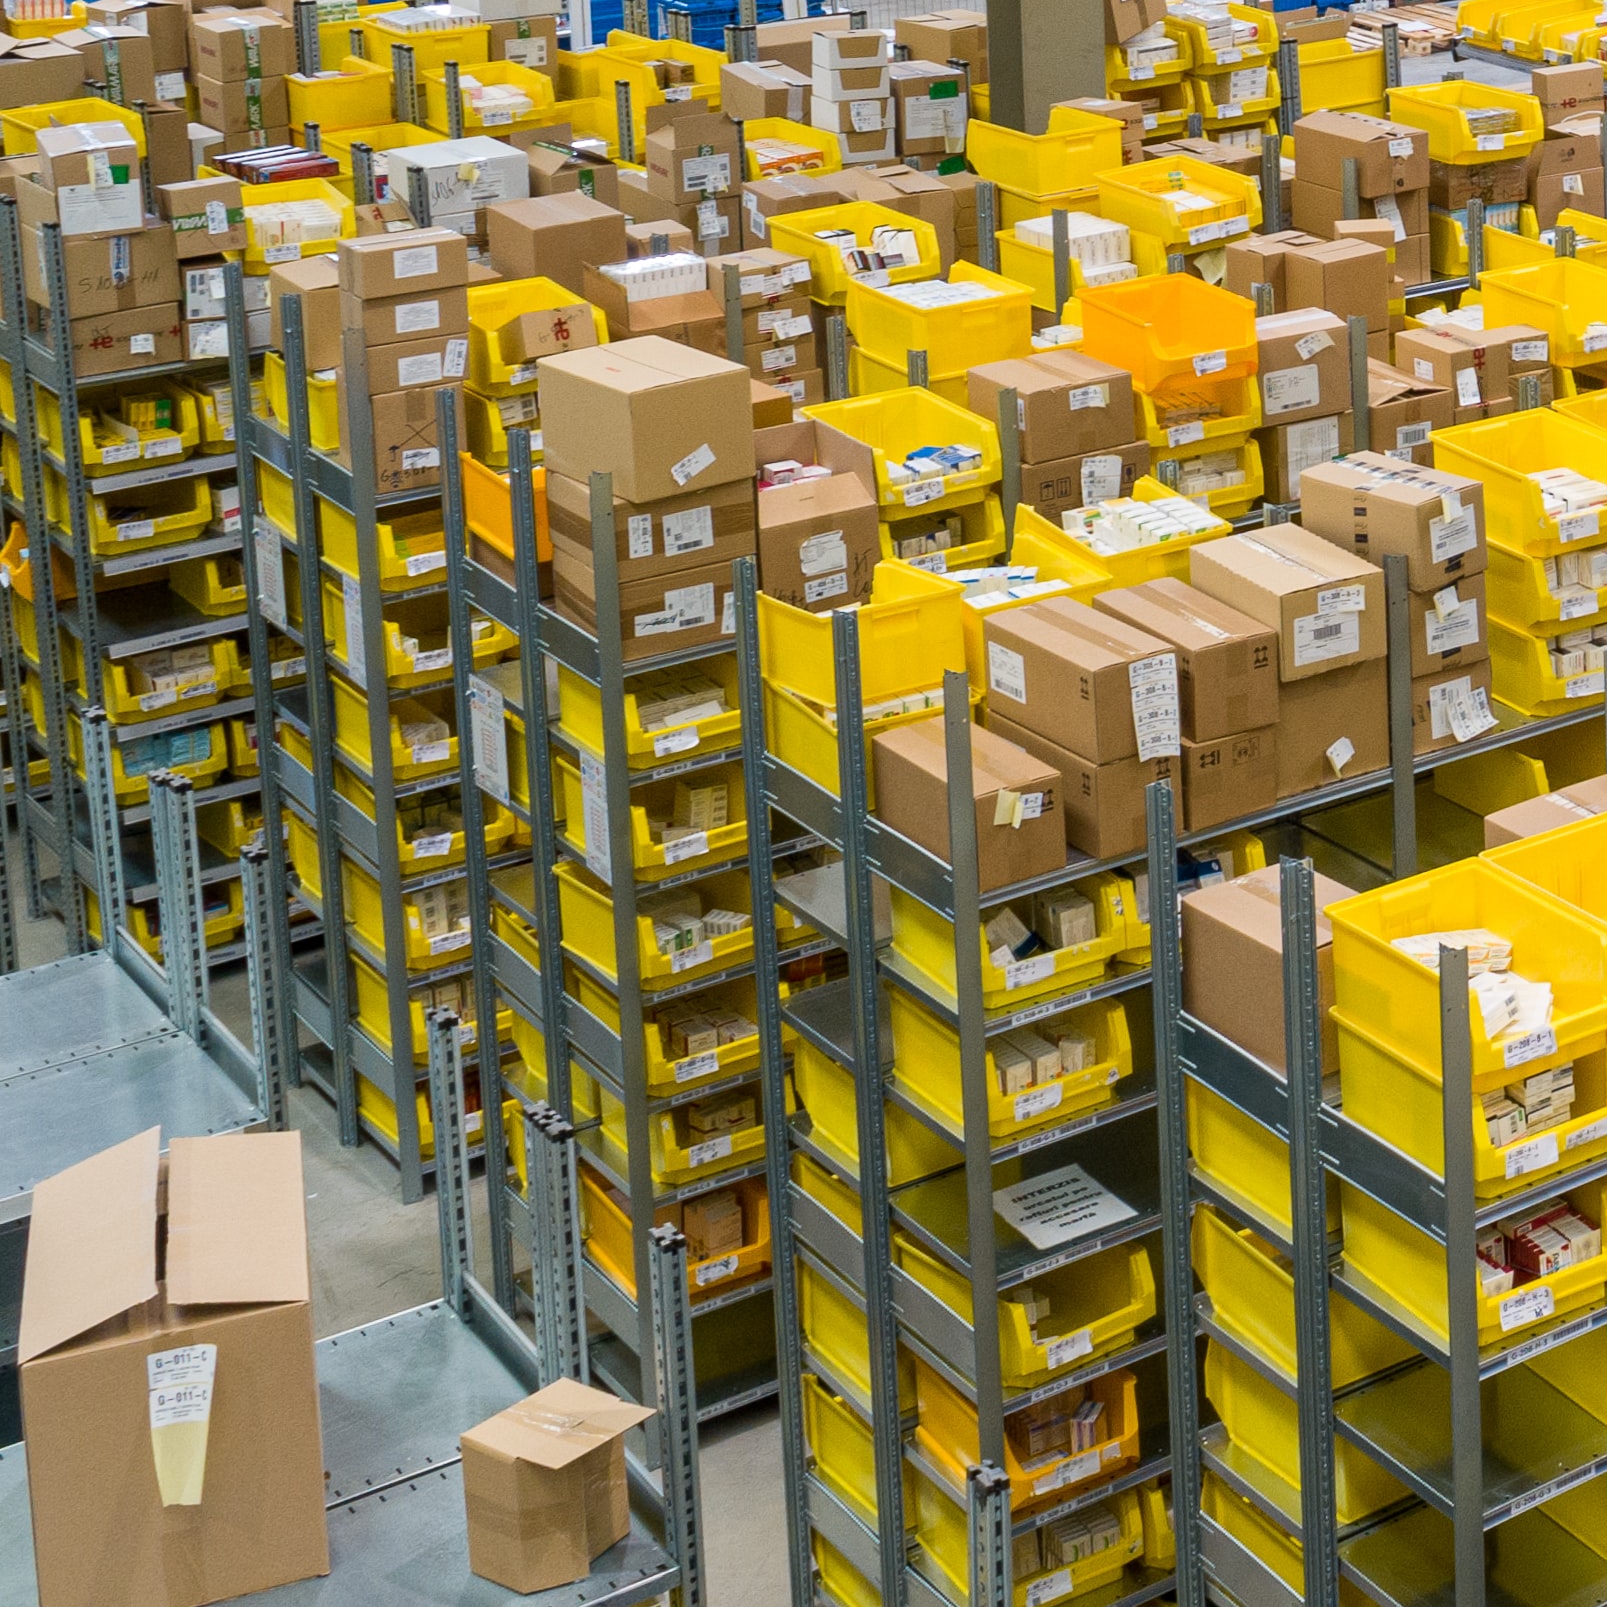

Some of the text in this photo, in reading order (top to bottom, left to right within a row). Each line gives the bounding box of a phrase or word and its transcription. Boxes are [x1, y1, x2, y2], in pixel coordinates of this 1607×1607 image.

[1012, 1177, 1081, 1205] INTERZIS
[155, 1350, 208, 1369] G-011-C
[157, 1390, 208, 1407] G-011-C
